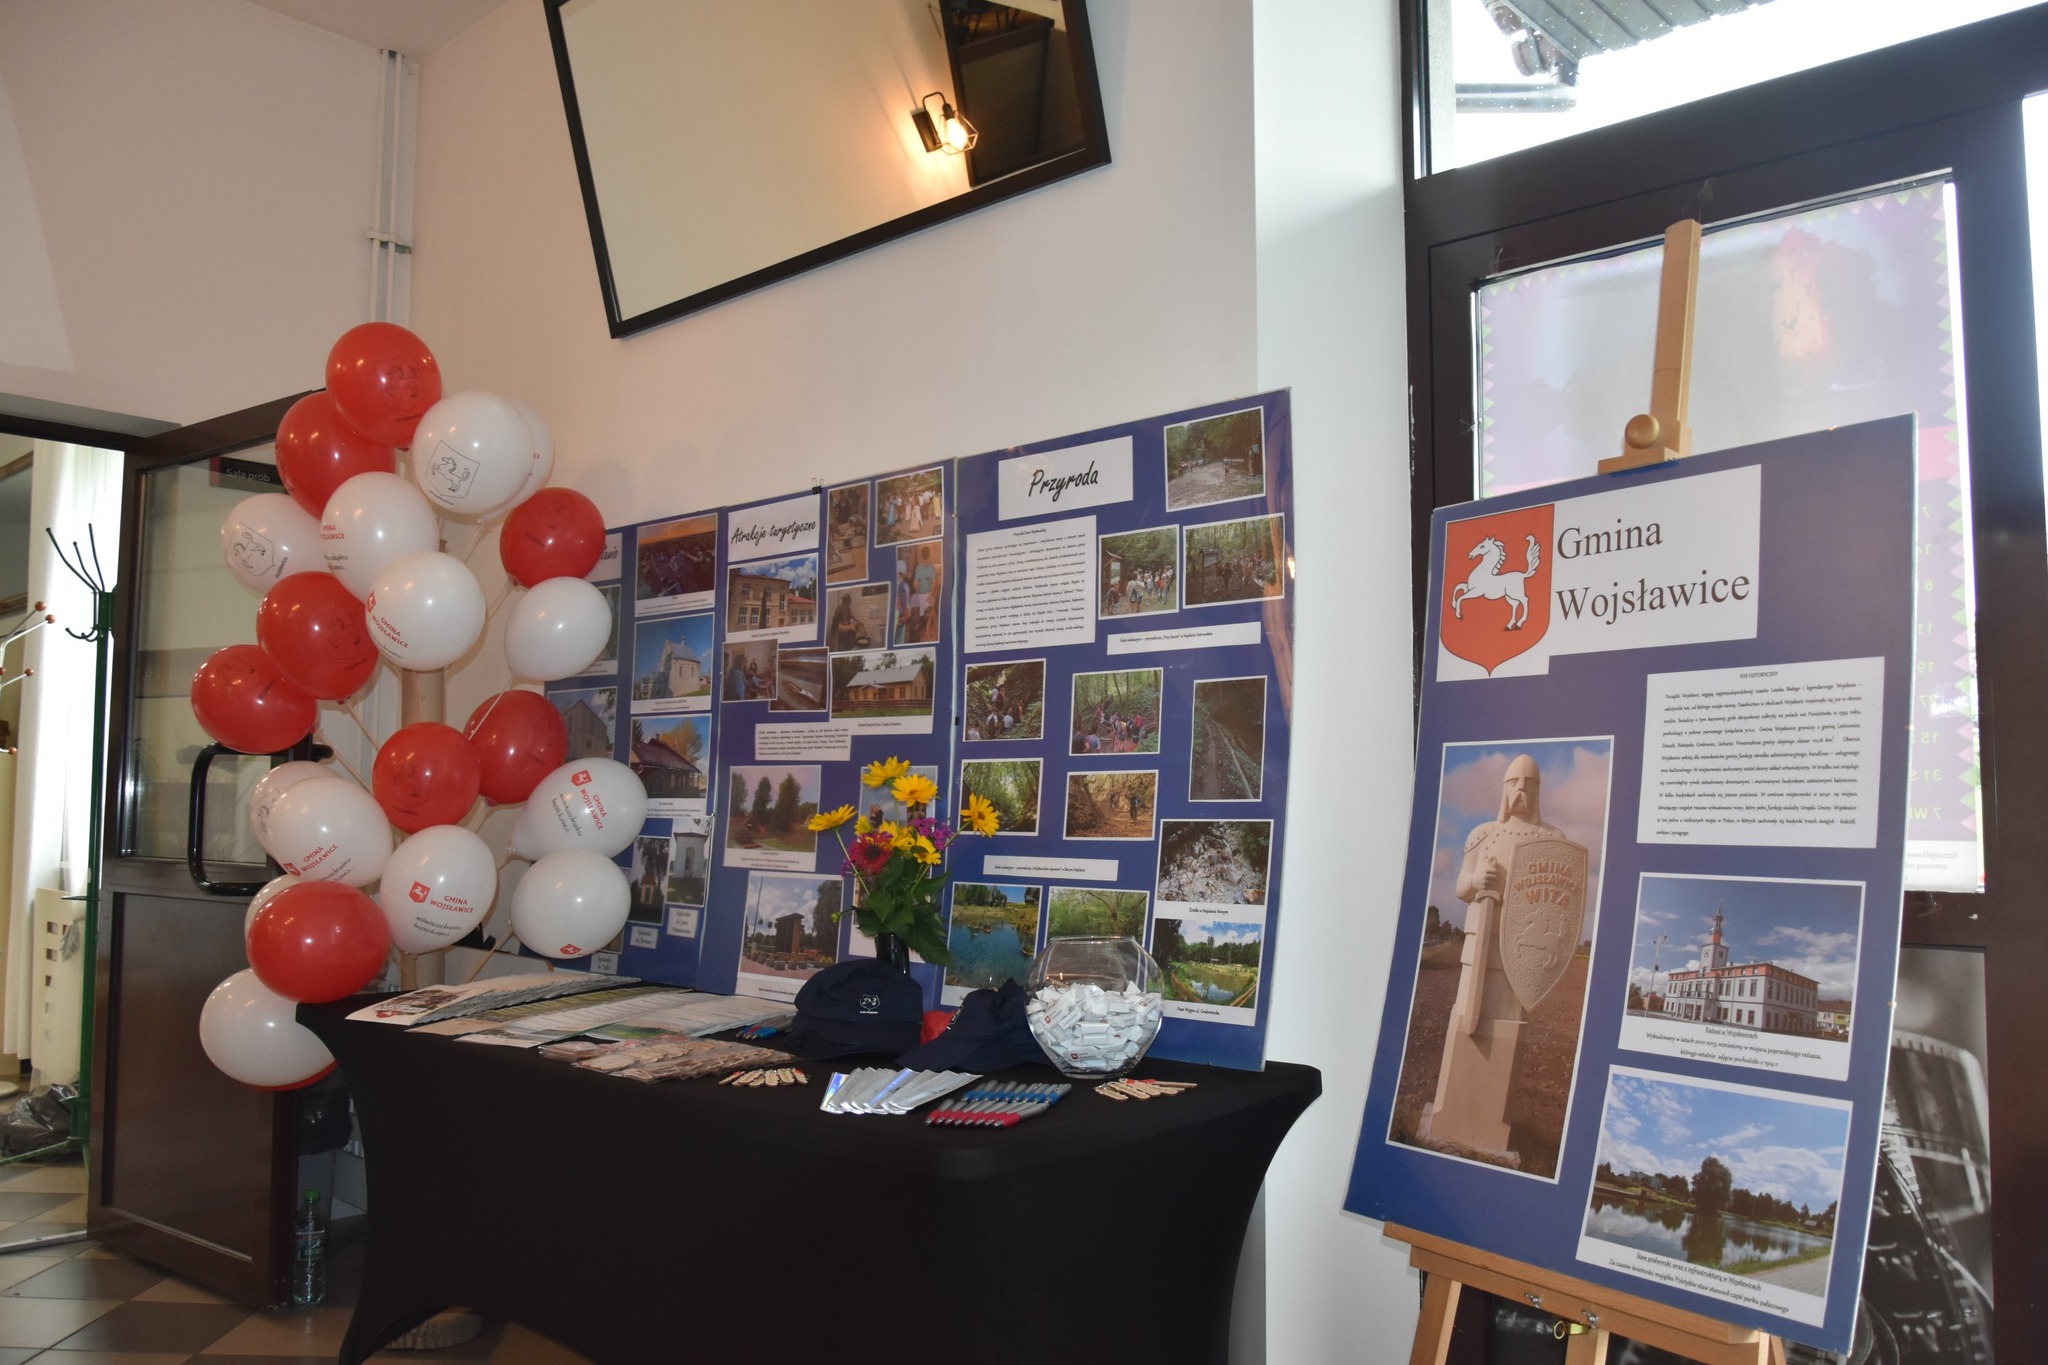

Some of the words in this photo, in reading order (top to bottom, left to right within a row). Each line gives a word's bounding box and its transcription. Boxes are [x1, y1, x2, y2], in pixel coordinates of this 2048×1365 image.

[226, 468, 246, 478] Sala
[248, 472, 270, 482] prób
[1028, 460, 1099, 502] Przyroda
[731, 524, 766, 546] Atrakcje
[770, 520, 816, 542] turystyczne
[1557, 518, 1663, 560] Gmina
[1556, 570, 1750, 625] Wojsławice
[380, 617, 401, 637] GMINA
[580, 788, 604, 830] WOJSŁAWICE
[592, 794, 607, 818] GMINA
[301, 844, 338, 872] WOJSŁAWICE
[303, 846, 324, 862] GMINA
[1528, 862, 1572, 876] GMINA
[430, 900, 474, 913] WOJSŁAWICE
[444, 896, 468, 905] GMINA
[1525, 888, 1570, 908] WITA
